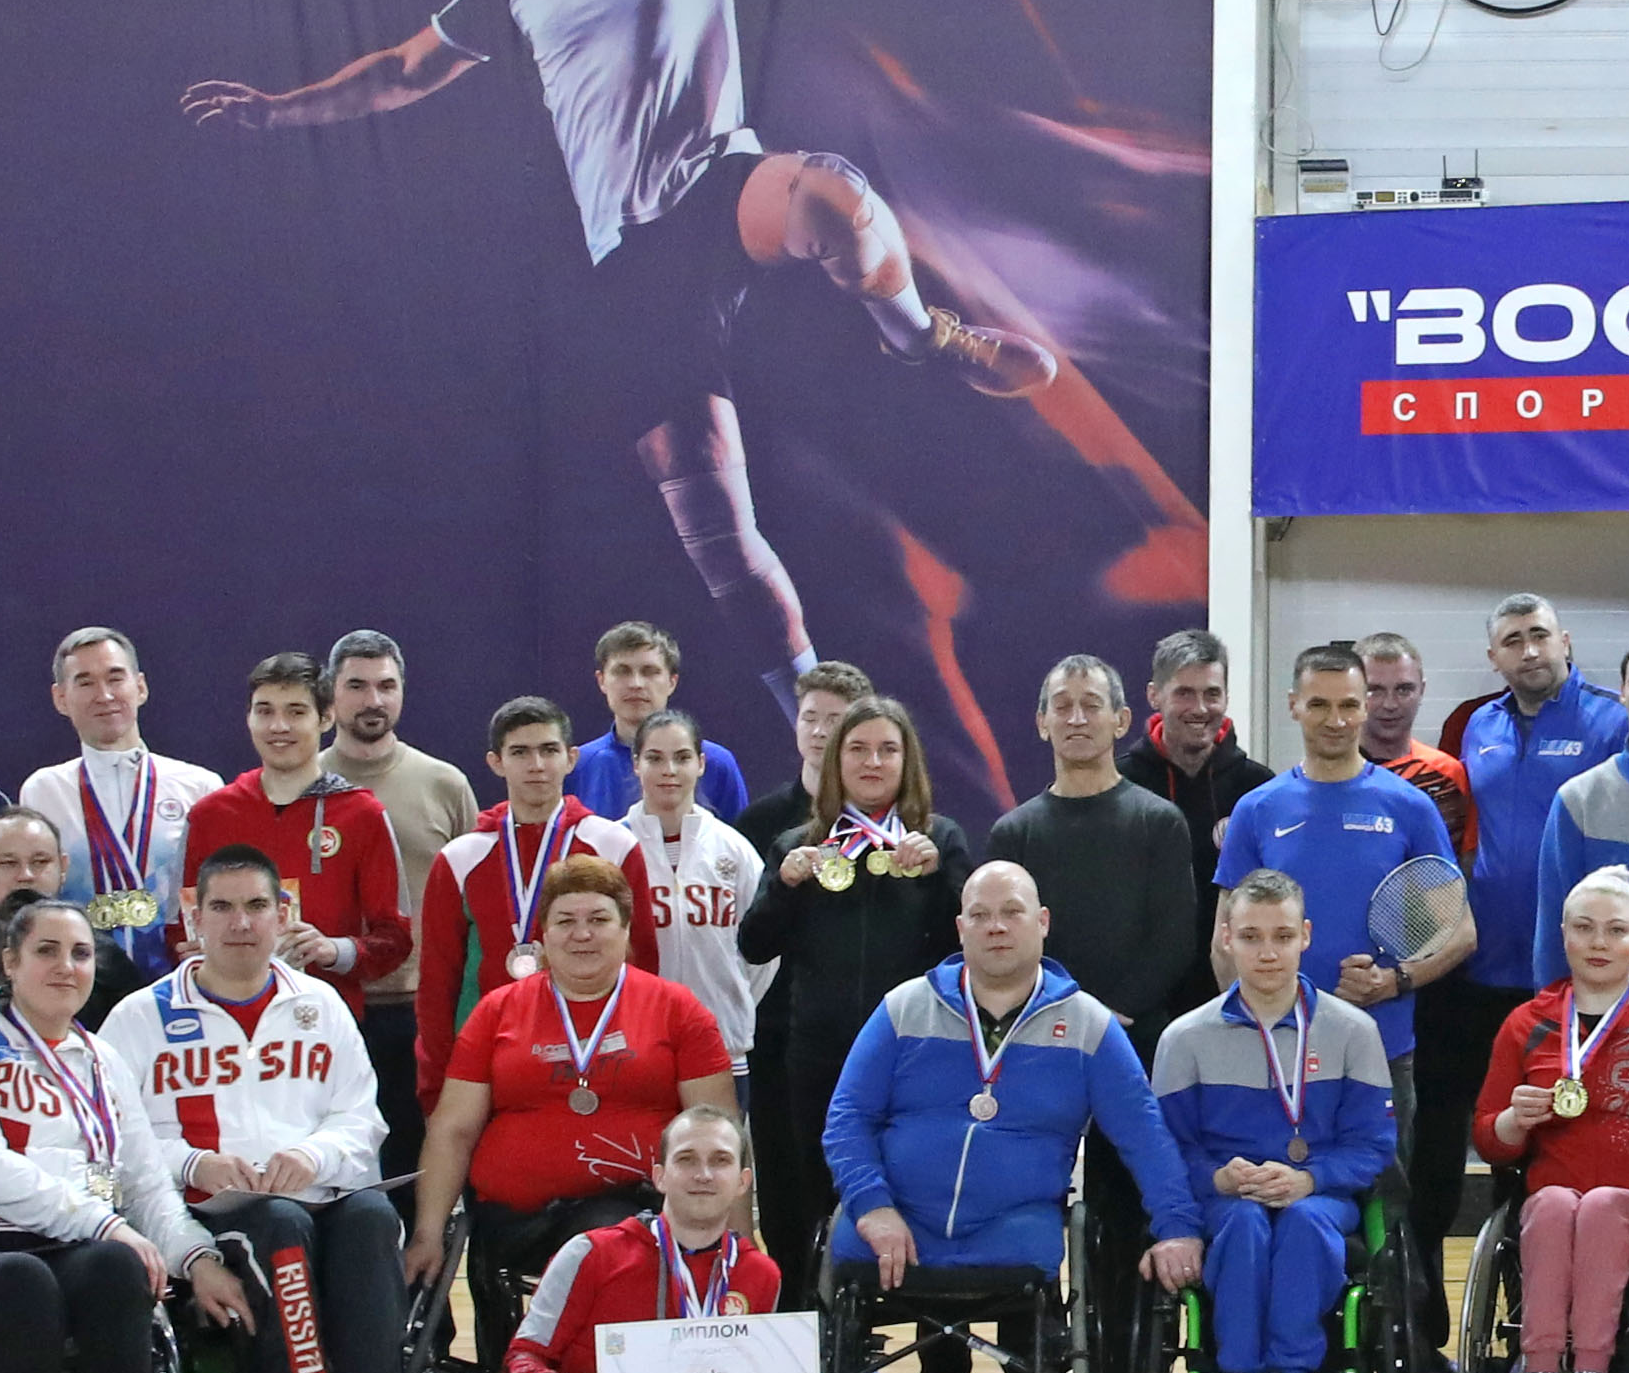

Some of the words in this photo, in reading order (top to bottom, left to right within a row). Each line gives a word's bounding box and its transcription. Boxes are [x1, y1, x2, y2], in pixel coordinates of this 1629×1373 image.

[1563, 741, 1583, 756] 63
[1374, 816, 1394, 834] 63
[650, 883, 737, 928] SSIA
[152, 1039, 334, 1095] RUSSIA
[670, 1323, 749, 1342] ДИПЛОМ
